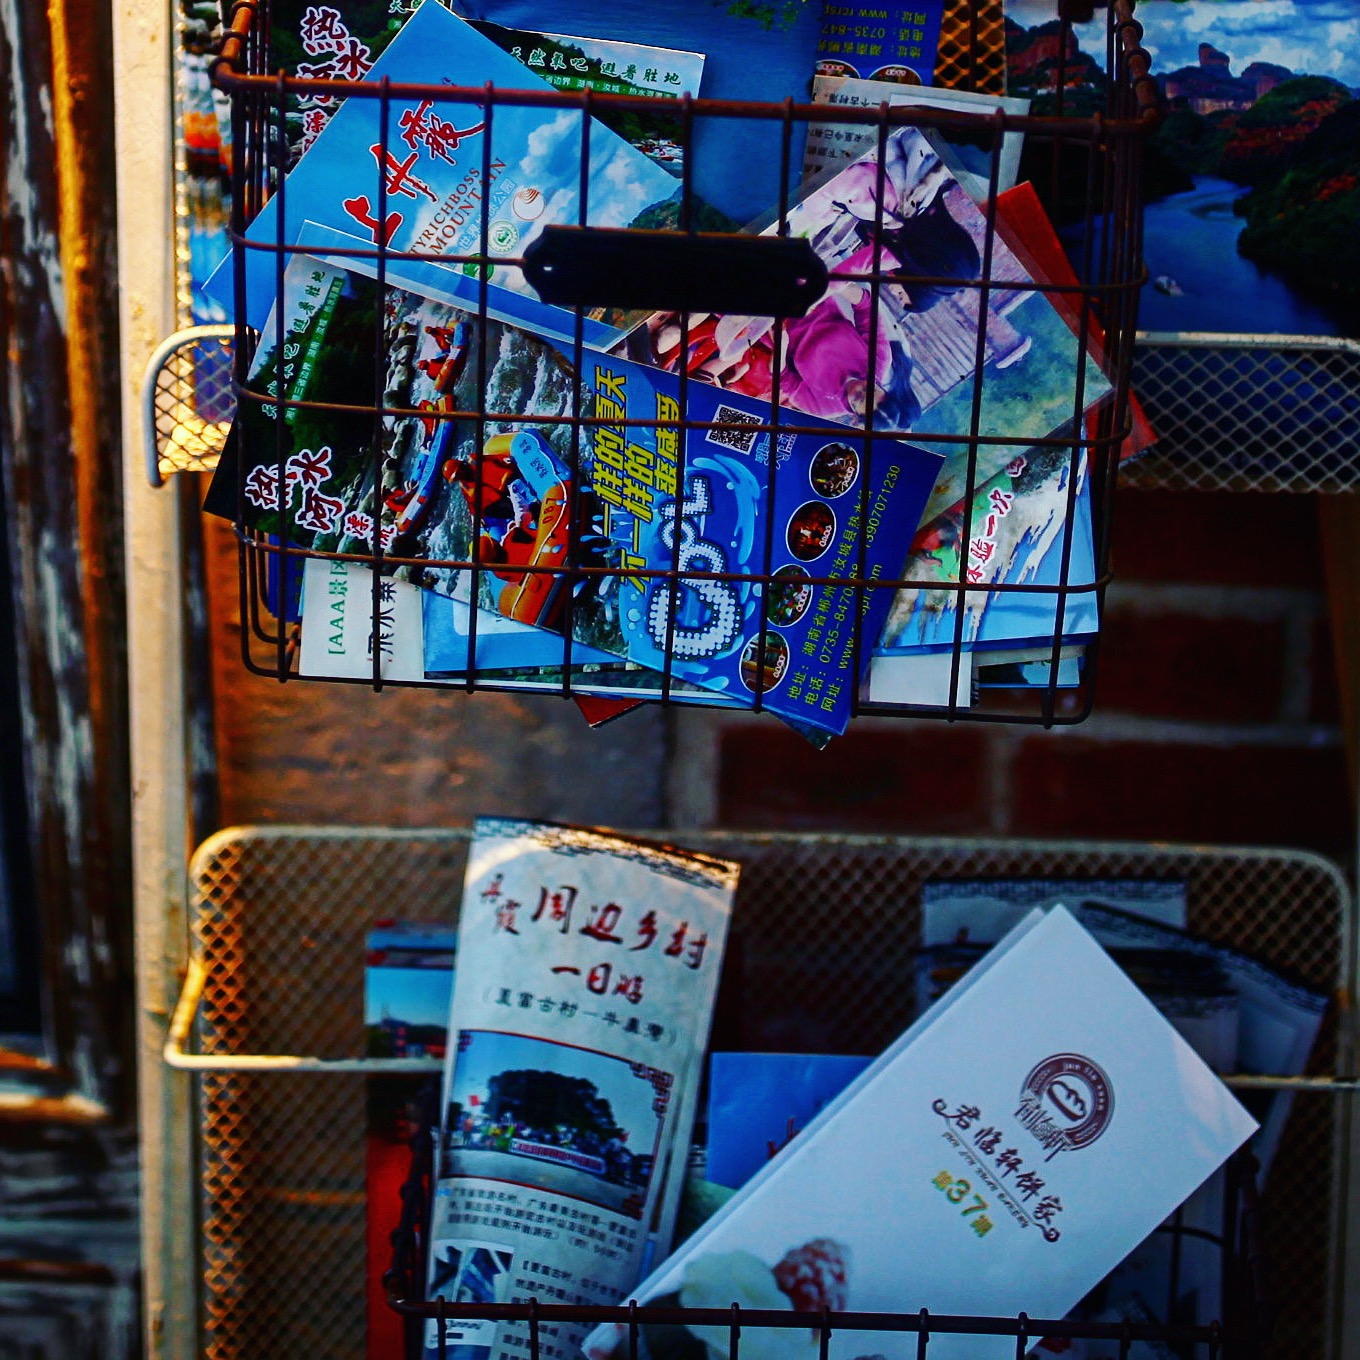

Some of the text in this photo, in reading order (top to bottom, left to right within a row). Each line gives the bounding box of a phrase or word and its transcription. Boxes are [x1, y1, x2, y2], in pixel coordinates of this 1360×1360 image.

[600, 61, 682, 86] 避暑胜地
[592, 366, 626, 537] 一样的夏天
[531, 885, 708, 970] 周边乡村
[551, 962, 644, 1004] 一日游
[952, 1104, 1063, 1225] 君临轩饼家
